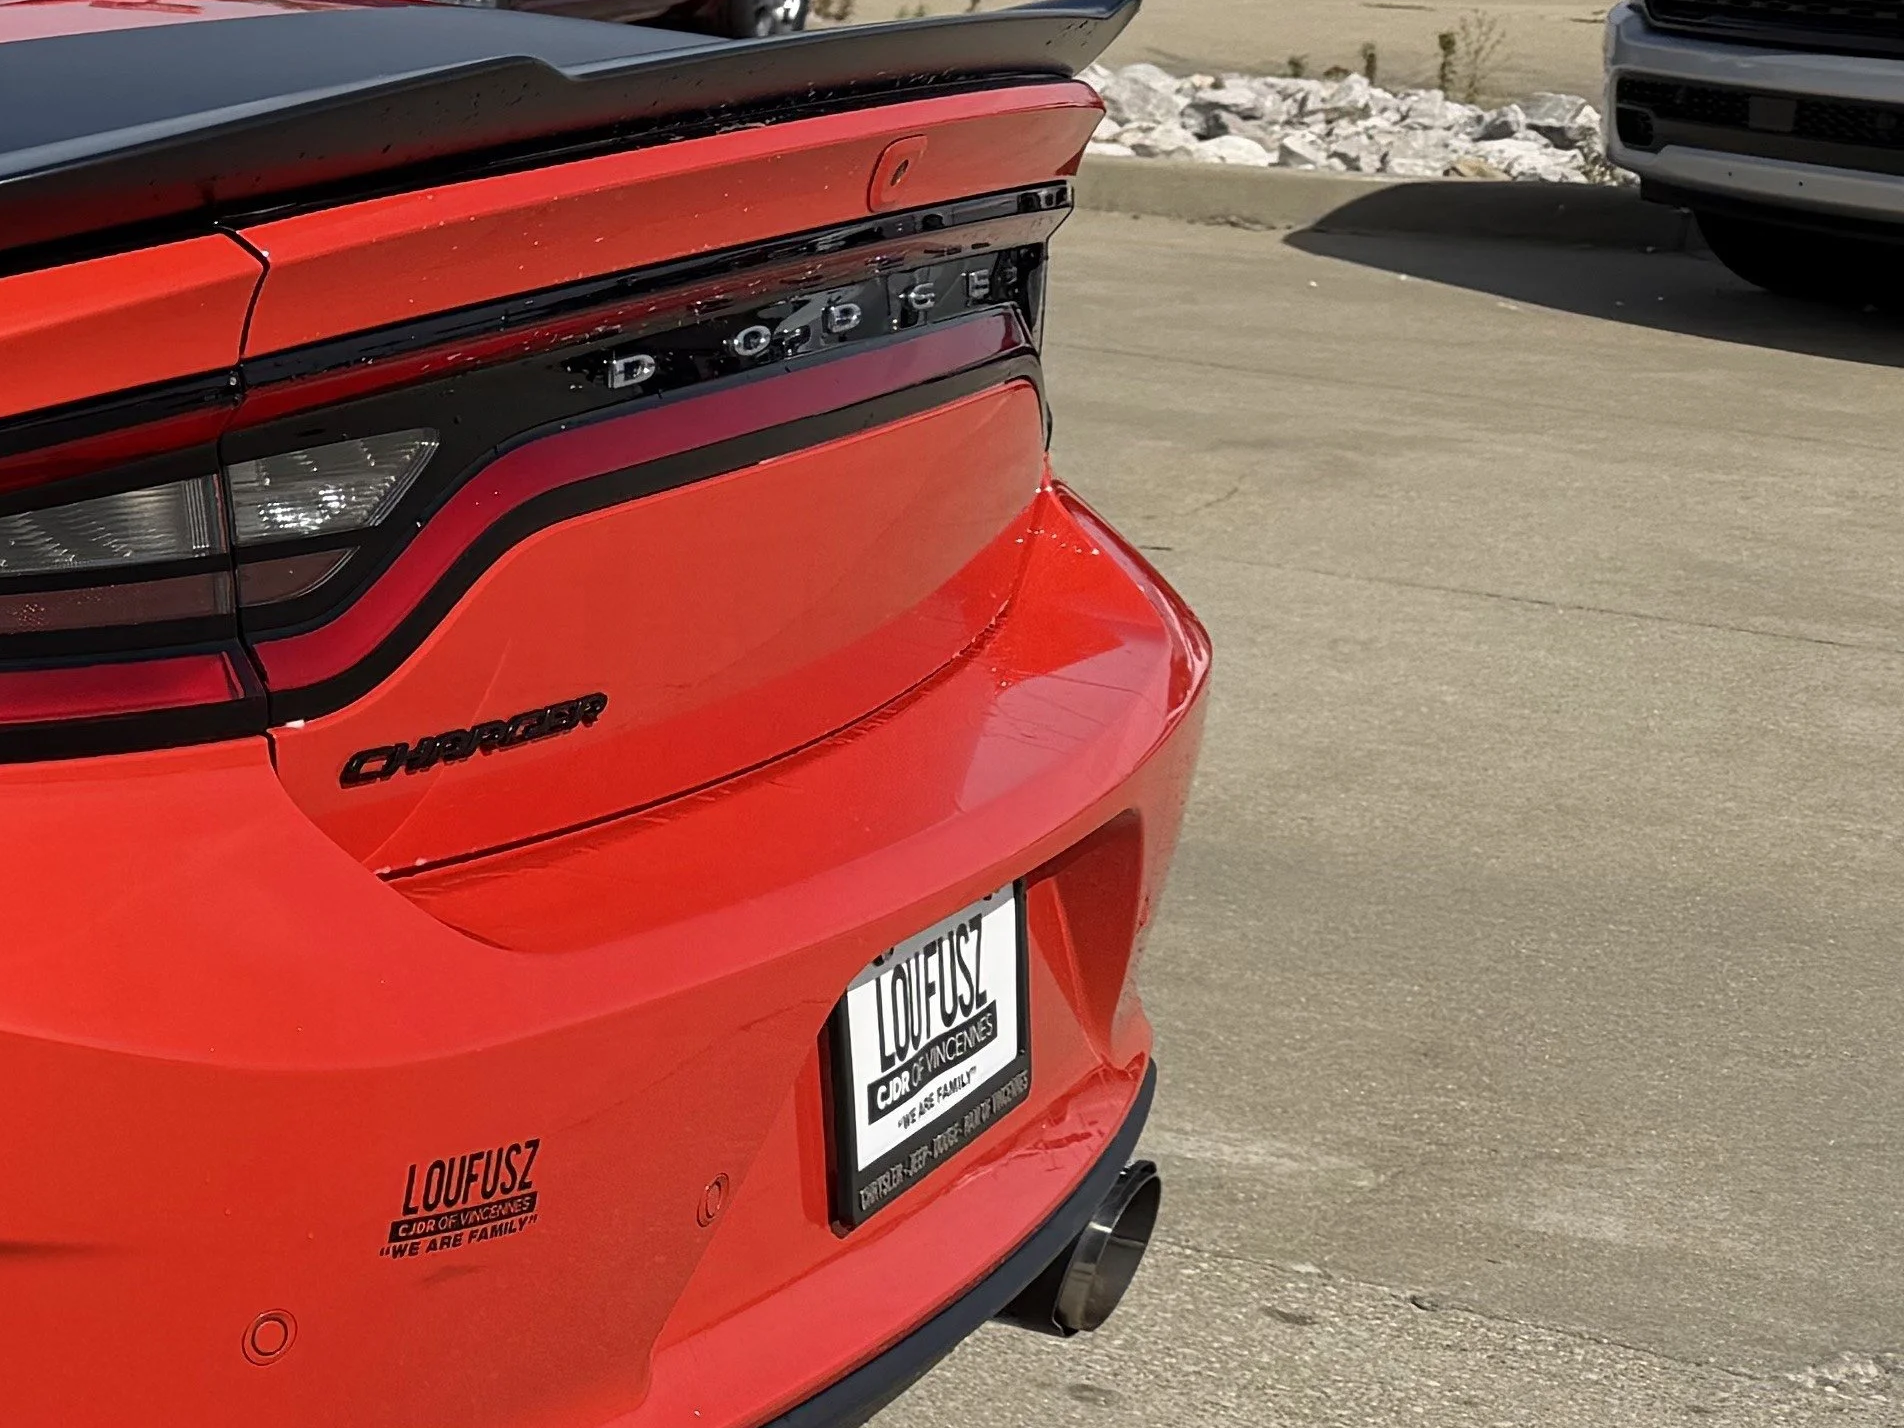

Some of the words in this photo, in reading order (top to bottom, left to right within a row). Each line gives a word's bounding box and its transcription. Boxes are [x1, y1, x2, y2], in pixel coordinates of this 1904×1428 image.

[607, 267, 992, 391] DODGE
[339, 692, 608, 789] CHARGER
[876, 1070, 911, 1111] CJDR
[912, 1056, 925, 1087] OF
[925, 1012, 993, 1073] VINCENNES
[425, 1232, 464, 1254] ARE
[437, 1213, 459, 1231] OF
[459, 1196, 532, 1227] VINCENNES
